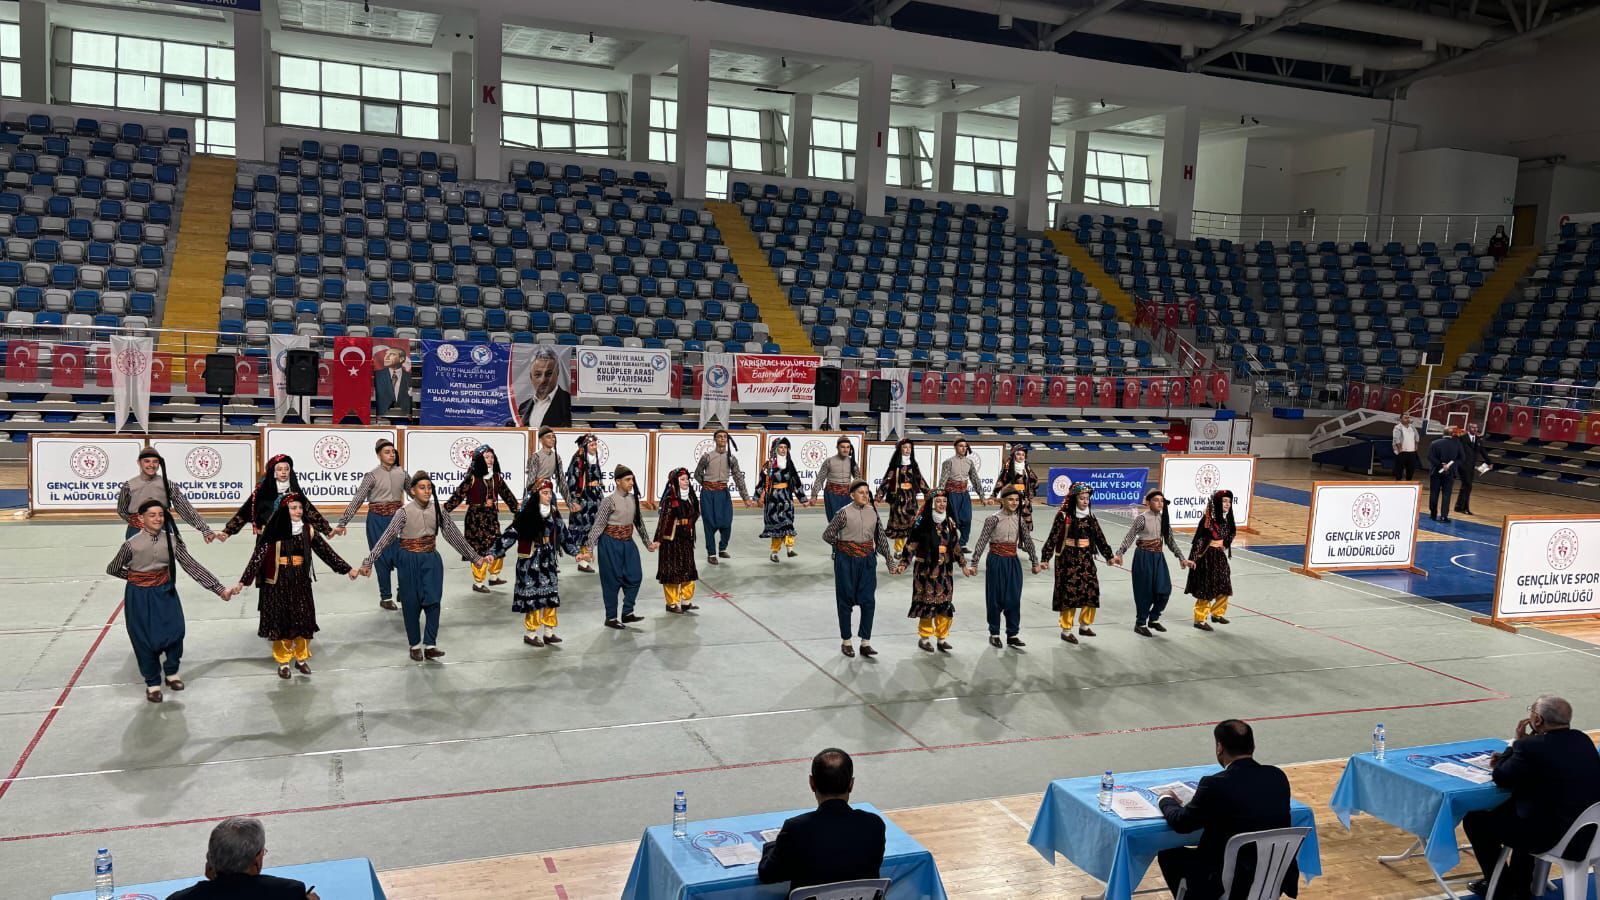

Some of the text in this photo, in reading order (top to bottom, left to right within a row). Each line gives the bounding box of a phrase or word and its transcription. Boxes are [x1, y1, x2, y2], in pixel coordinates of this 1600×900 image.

[483, 86, 496, 104] K
[1184, 165, 1193, 180] H
[605, 353, 628, 361] TÜRKİYE
[597, 366, 632, 375] KULÜPLER
[334, 472, 348, 481] VE
[351, 472, 364, 481] SP
[430, 470, 466, 483] ENÇLİK
[46, 480, 124, 492] GENÇLİK VE SPO
[175, 480, 204, 490] NÇLİK
[219, 481, 243, 489] SPOR
[302, 484, 358, 496] MÜDÜRLÜ
[1109, 481, 1121, 489] VE
[1122, 481, 1142, 489] SPOR
[50, 491, 60, 501] İL
[1173, 495, 1206, 508] GENÇLİK
[1176, 509, 1182, 519] İL
[1325, 529, 1401, 543] GENÇLİK VE SPOR
[1328, 544, 1395, 557] İL MÜDÜRLÜĞÜ
[1517, 572, 1600, 588] GENÇLİK VE SPOR
[1519, 588, 1594, 605] İL MÜDÜRLÜĞÜ
